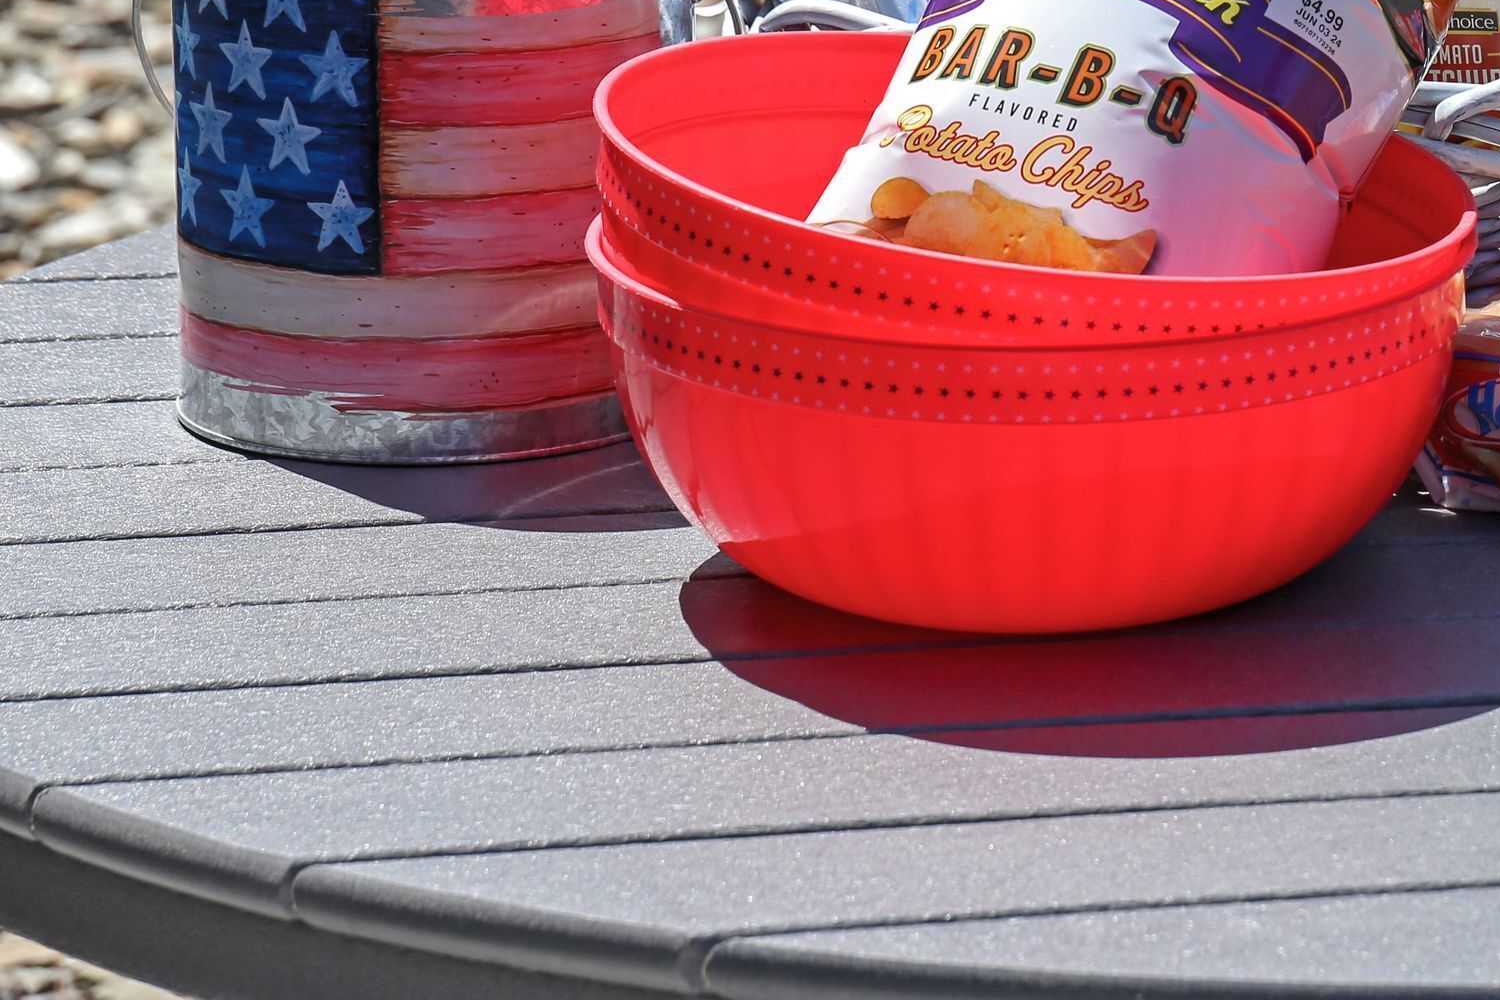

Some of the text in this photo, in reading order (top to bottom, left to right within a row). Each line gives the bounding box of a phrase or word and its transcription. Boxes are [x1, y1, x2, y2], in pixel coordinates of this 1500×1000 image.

[1296, 7, 1342, 48] JUN 03 24
[1432, 44, 1483, 65] MATO
[908, 24, 1198, 147] BAR-B-Q
[968, 93, 1080, 132] FLAVORED
[879, 104, 1150, 212] Potato Chips
